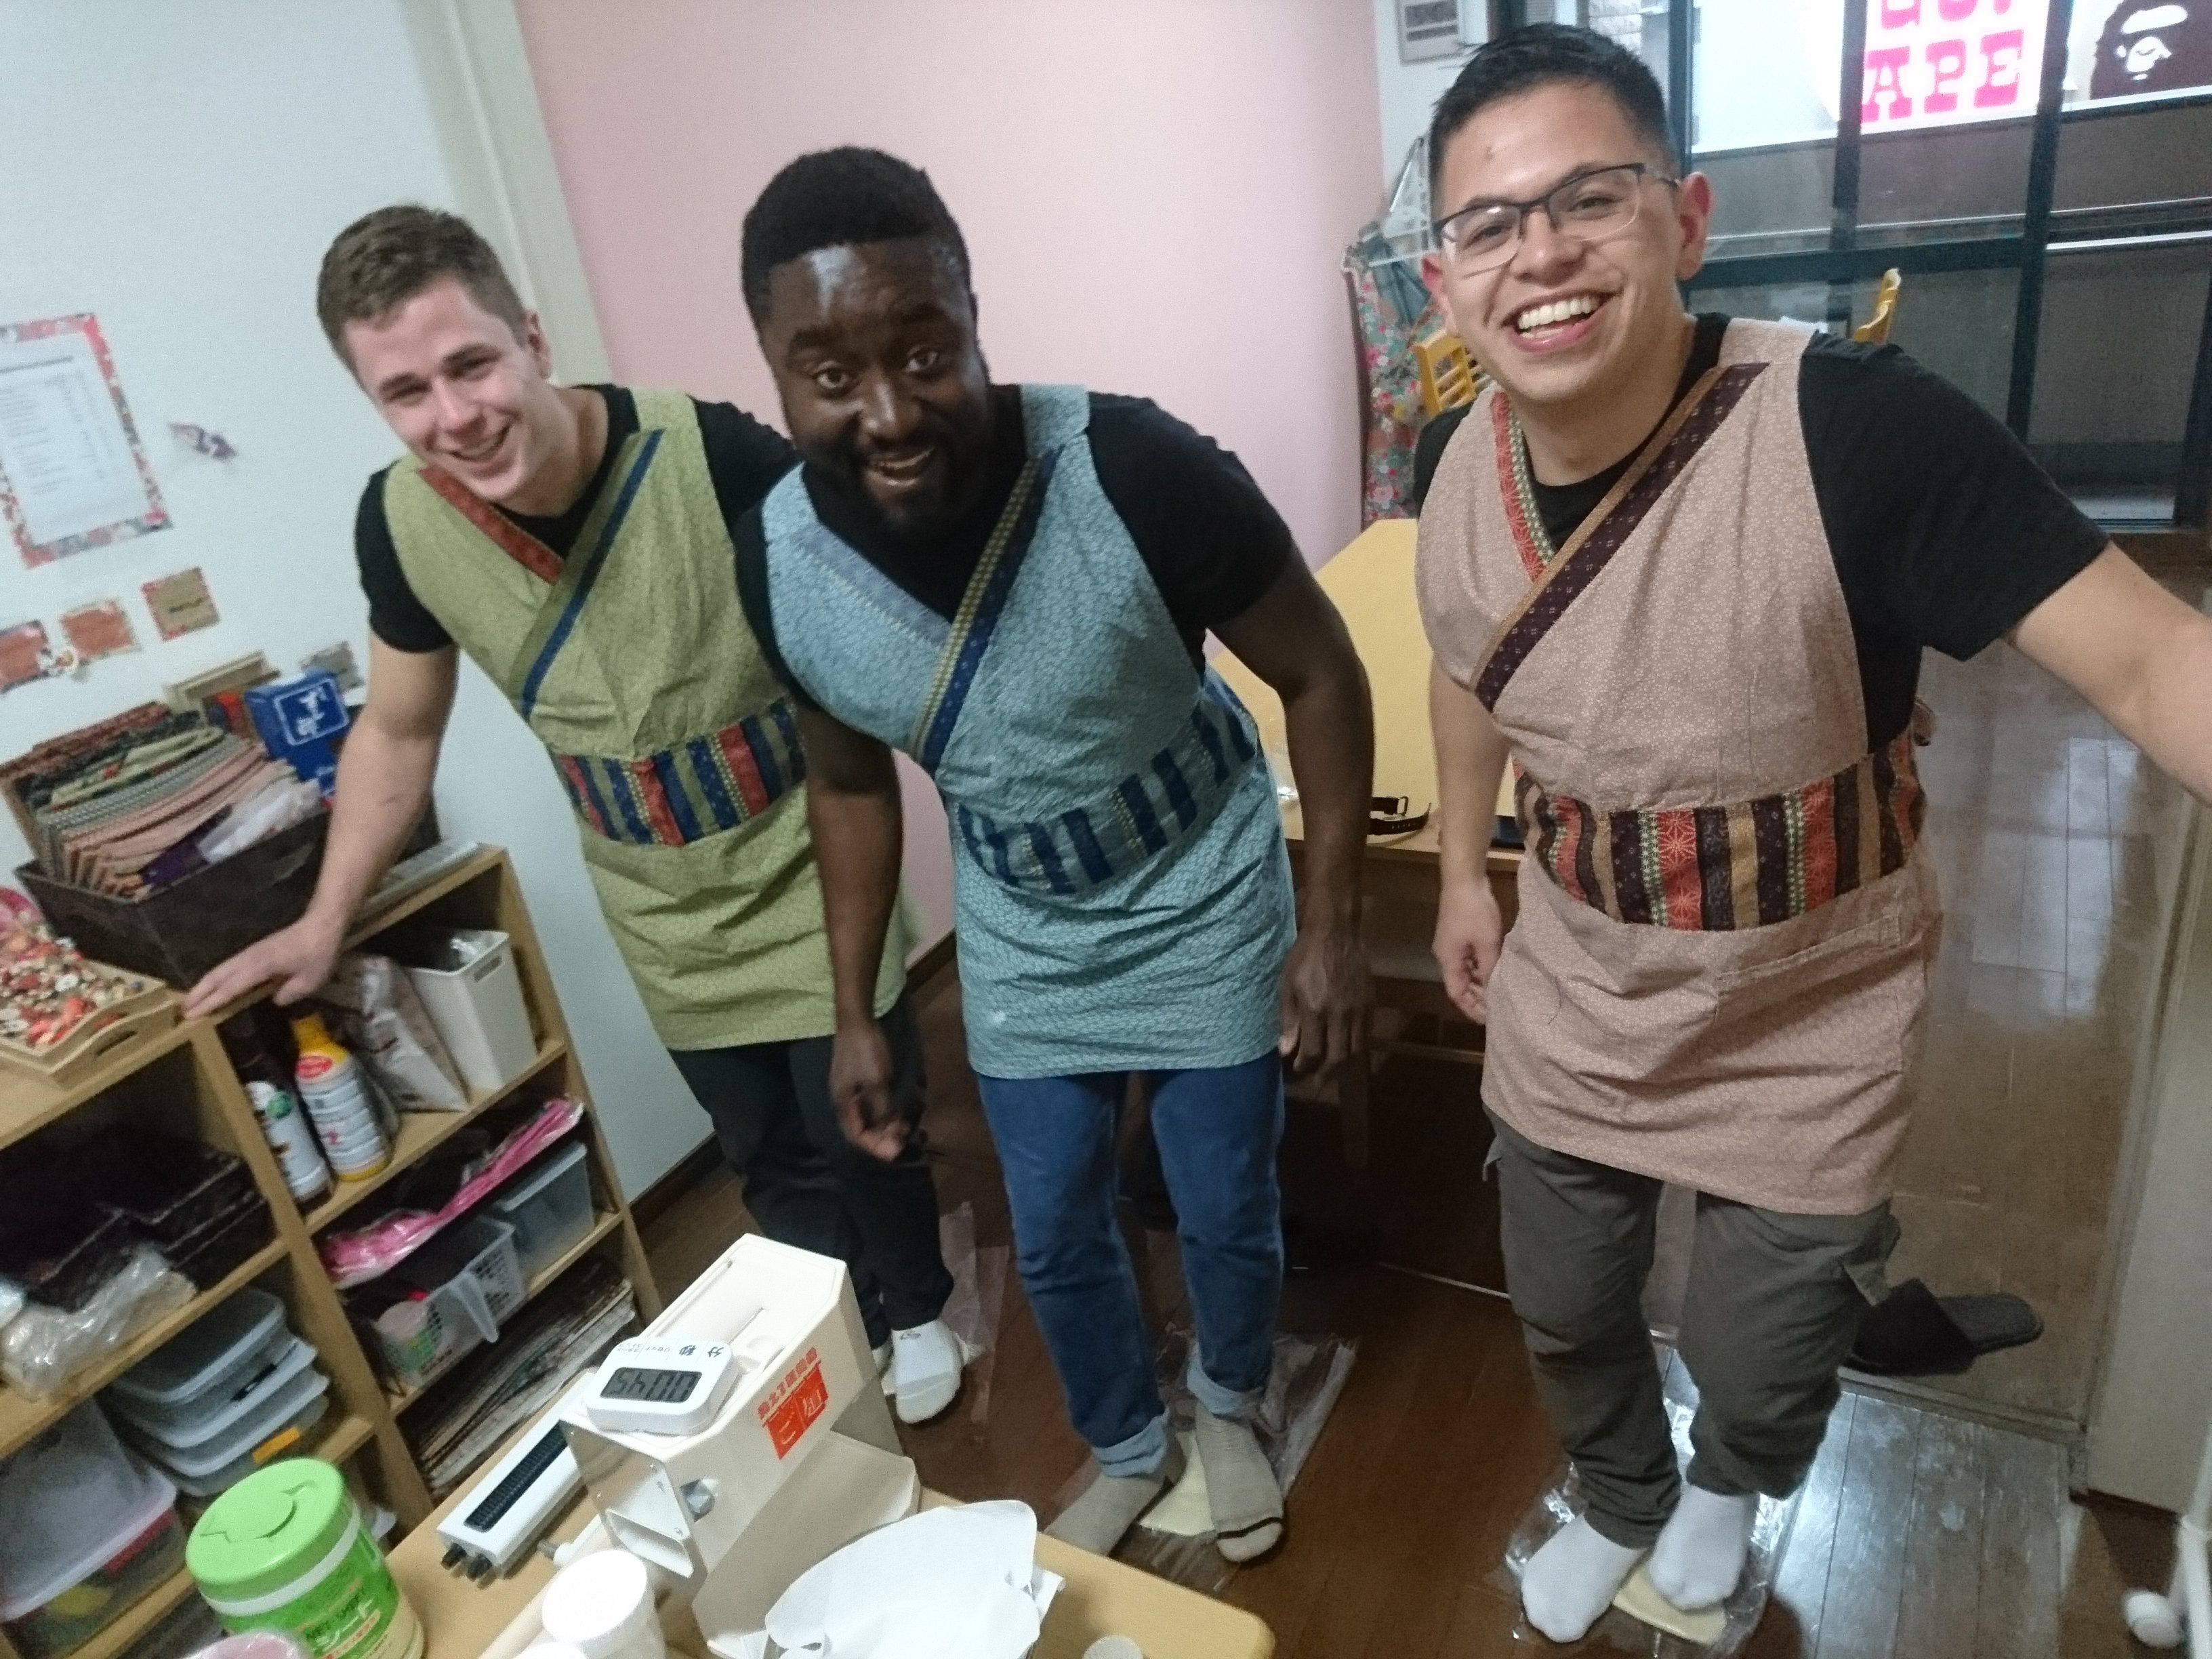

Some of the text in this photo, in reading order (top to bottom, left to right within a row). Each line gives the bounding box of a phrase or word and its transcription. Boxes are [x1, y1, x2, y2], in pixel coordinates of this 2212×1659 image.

[1862, 29, 2024, 123] APE
[644, 1345, 724, 1358] 分 秒 リセット
